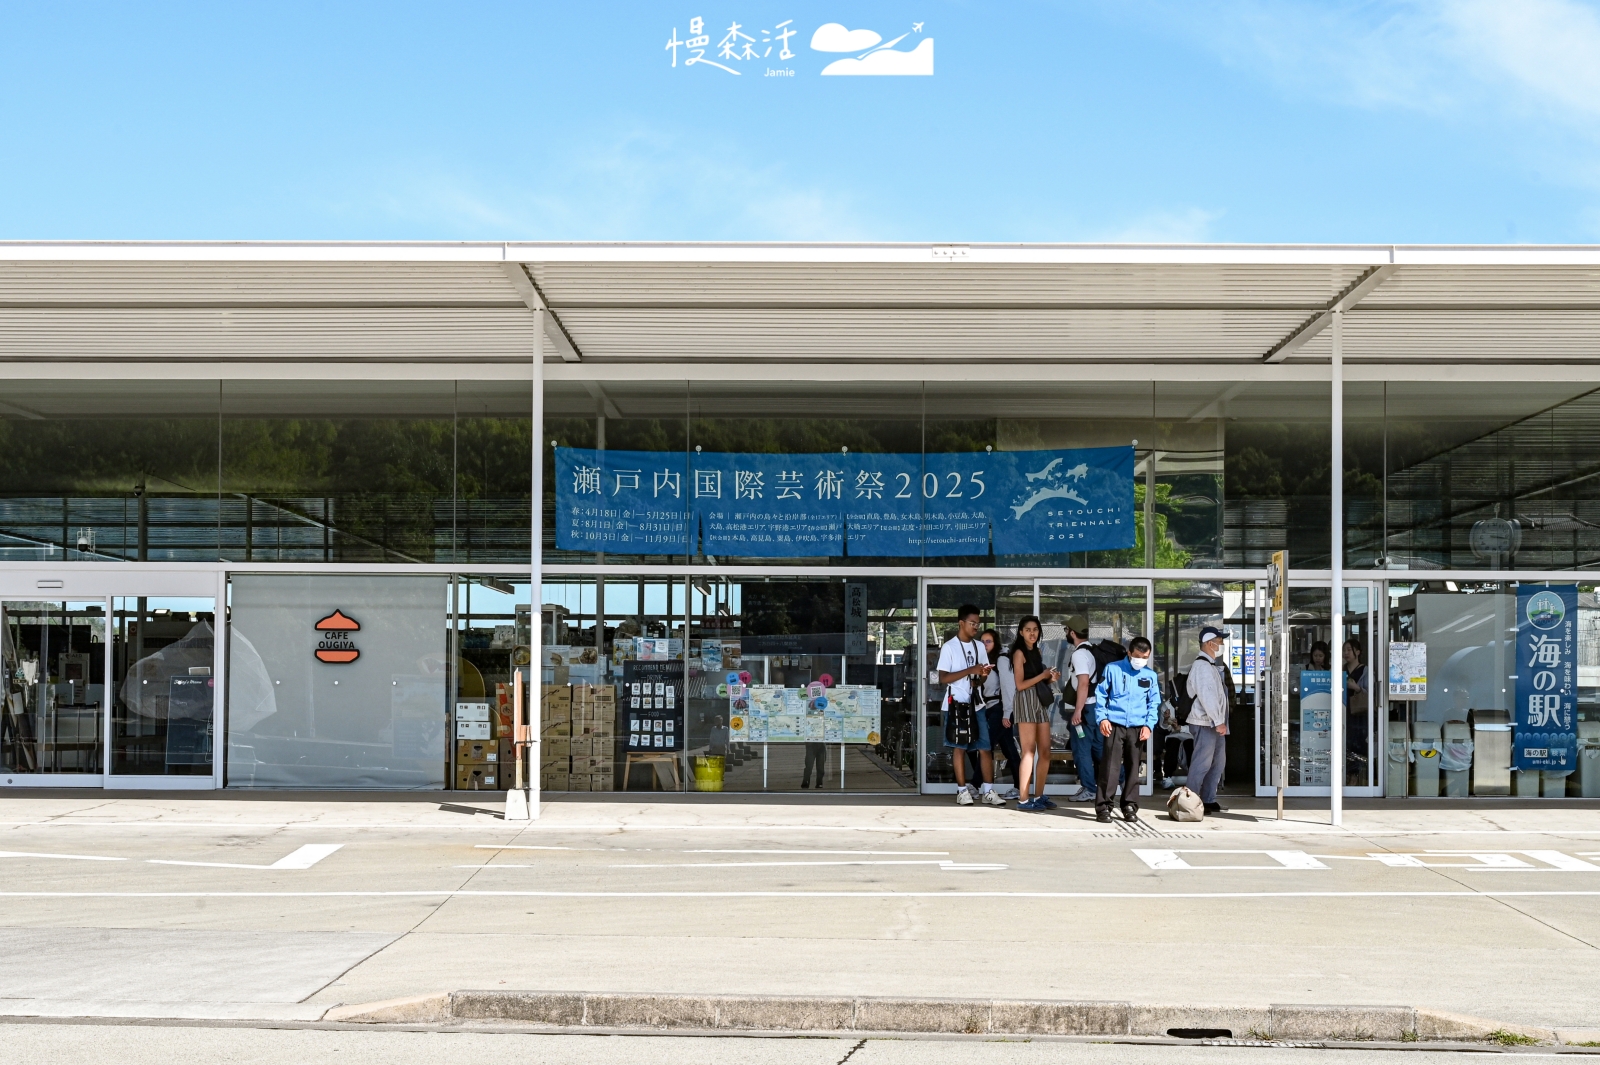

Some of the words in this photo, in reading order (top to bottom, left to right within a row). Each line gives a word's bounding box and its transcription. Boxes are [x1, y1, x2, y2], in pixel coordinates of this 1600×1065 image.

[572, 465, 985, 500] 瀬戸内国際芸術祭2025
[1047, 507, 1121, 517] SETOUCHI
[1048, 518, 1121, 528] TRIENNALE
[318, 641, 355, 649] OUGIYA
[1527, 634, 1562, 727] 海の駅
[1525, 749, 1547, 757] 海の駅
